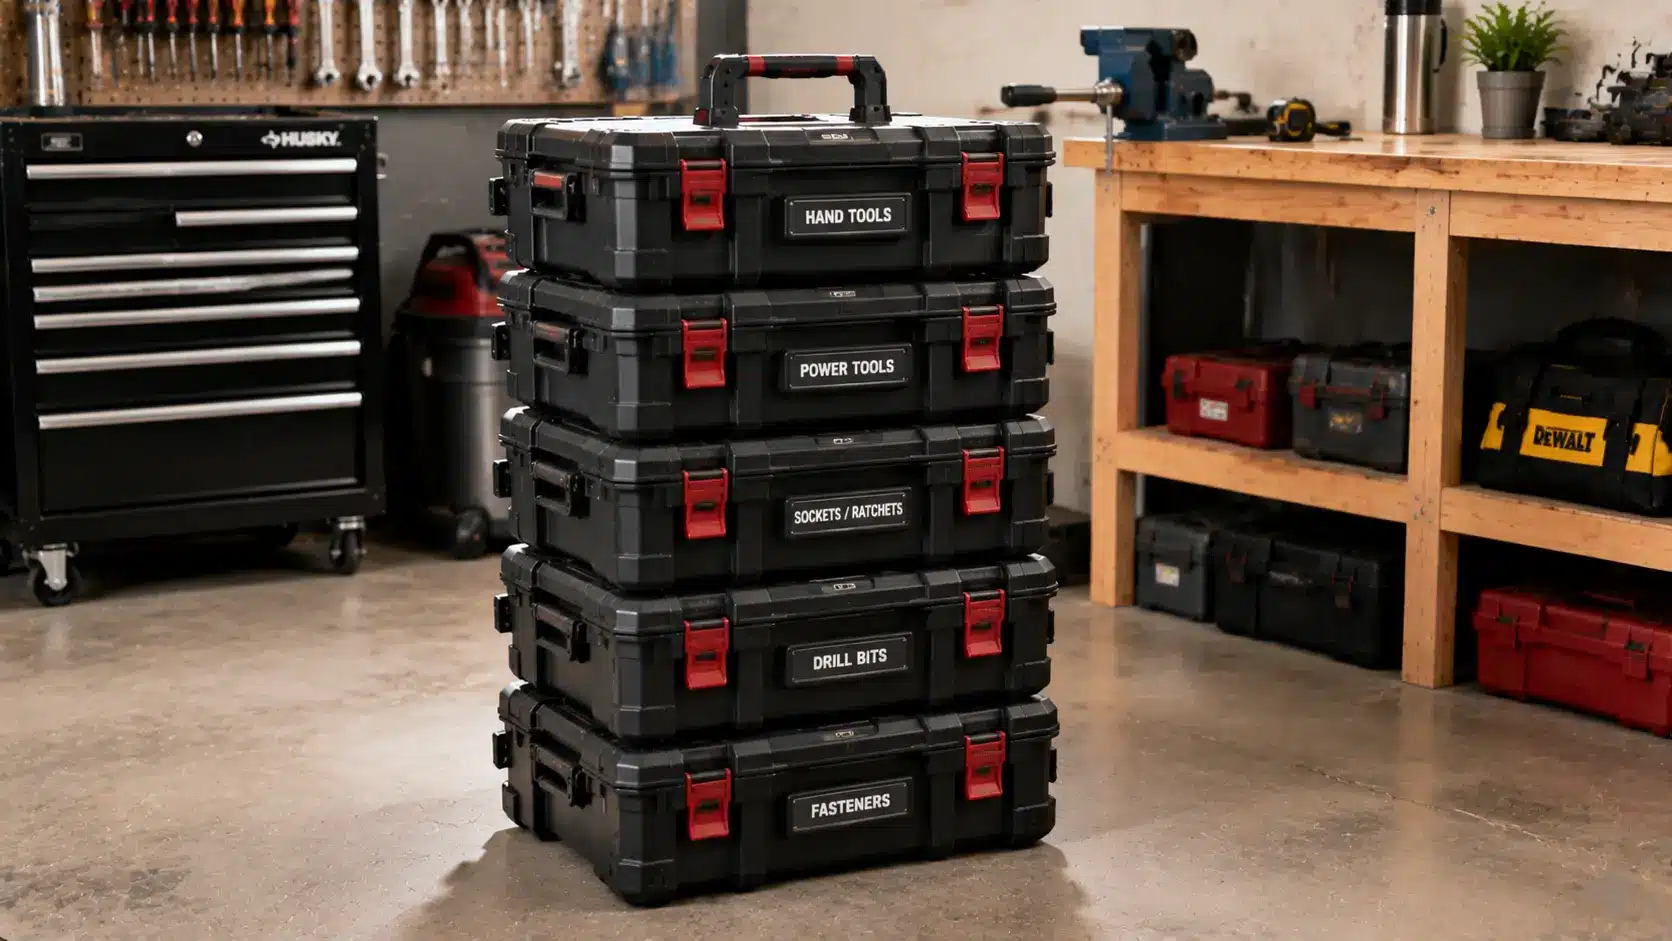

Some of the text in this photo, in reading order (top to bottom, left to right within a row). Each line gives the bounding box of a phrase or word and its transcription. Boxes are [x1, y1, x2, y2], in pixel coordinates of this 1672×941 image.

[805, 207, 892, 224] HAND TOOLS
[800, 359, 895, 378] POWER TOOLS
[794, 502, 903, 524] SOCKETS / RATCHETS
[813, 648, 887, 670] DRILL BITS
[811, 793, 890, 818] FASTENERS
